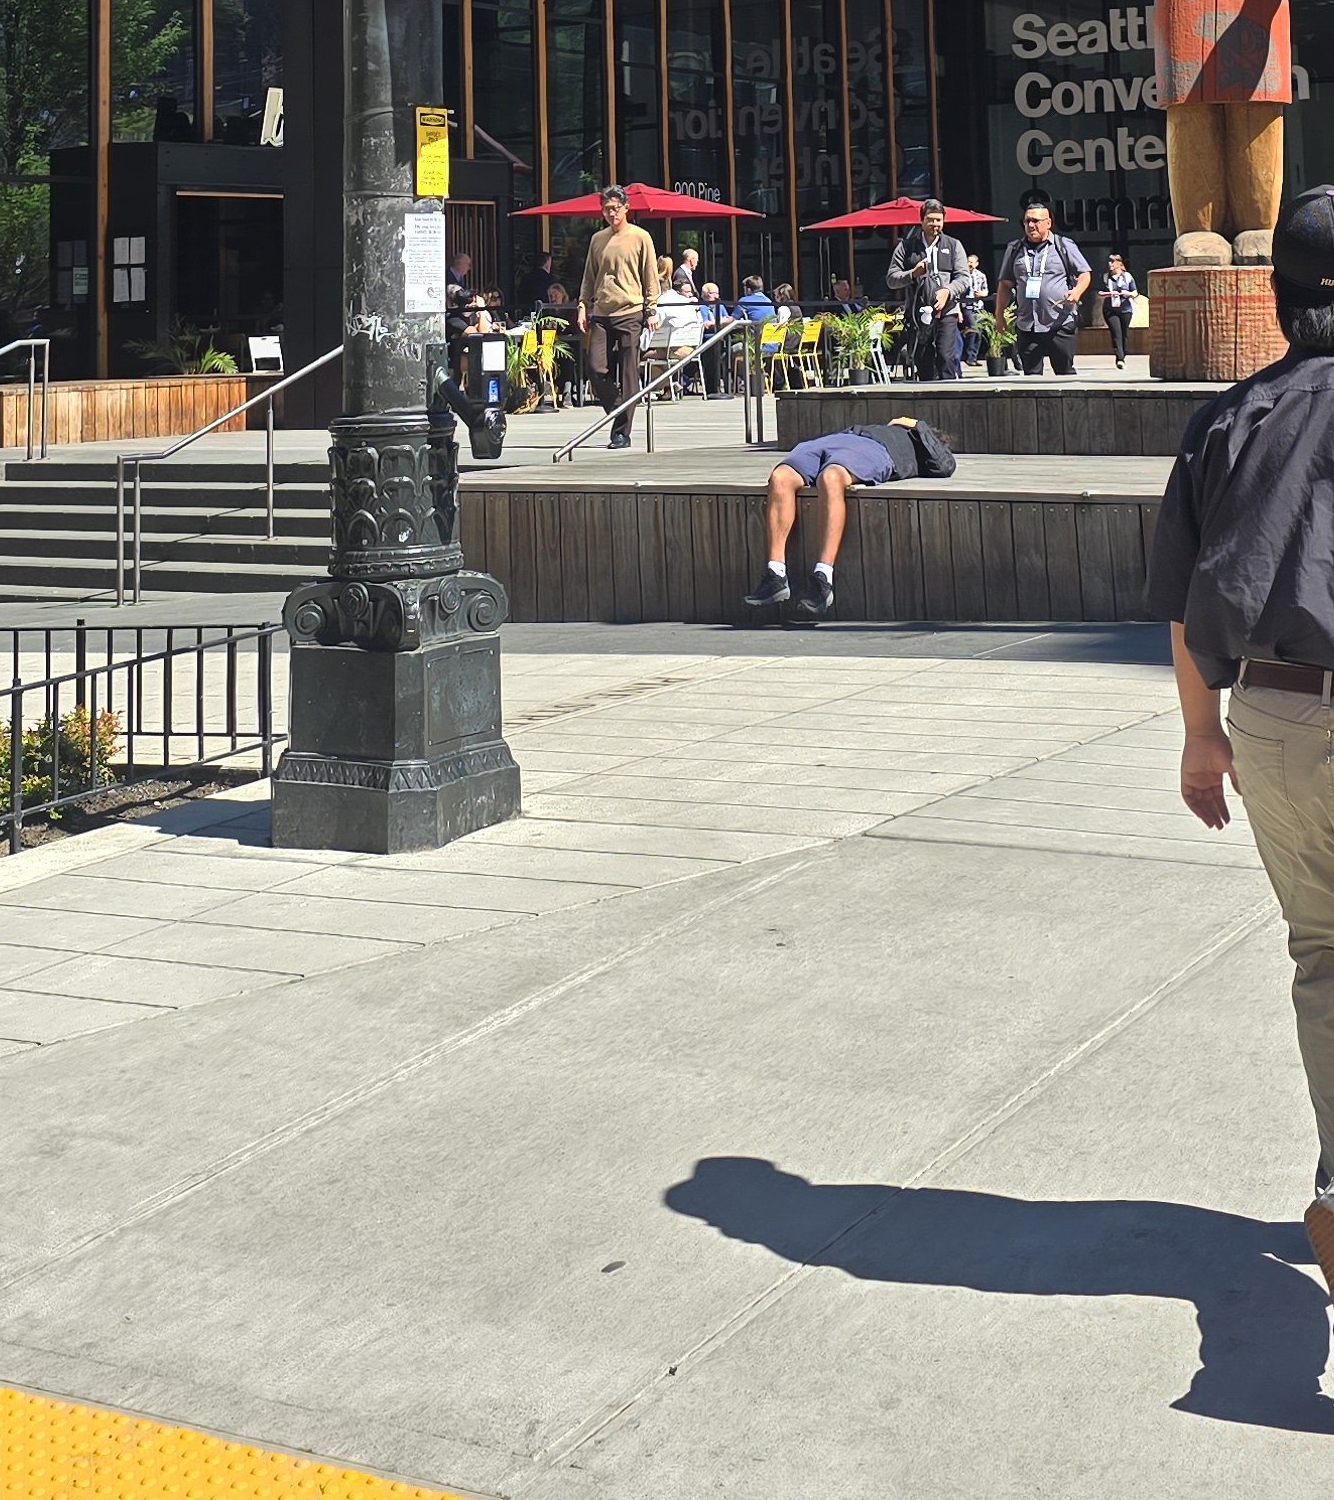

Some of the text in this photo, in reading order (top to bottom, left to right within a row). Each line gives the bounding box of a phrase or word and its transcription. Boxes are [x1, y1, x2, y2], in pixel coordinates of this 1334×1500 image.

[1010, 4, 1156, 60] Seattl
[1015, 126, 1167, 177] Cente
[697, 182, 721, 202] Pine
